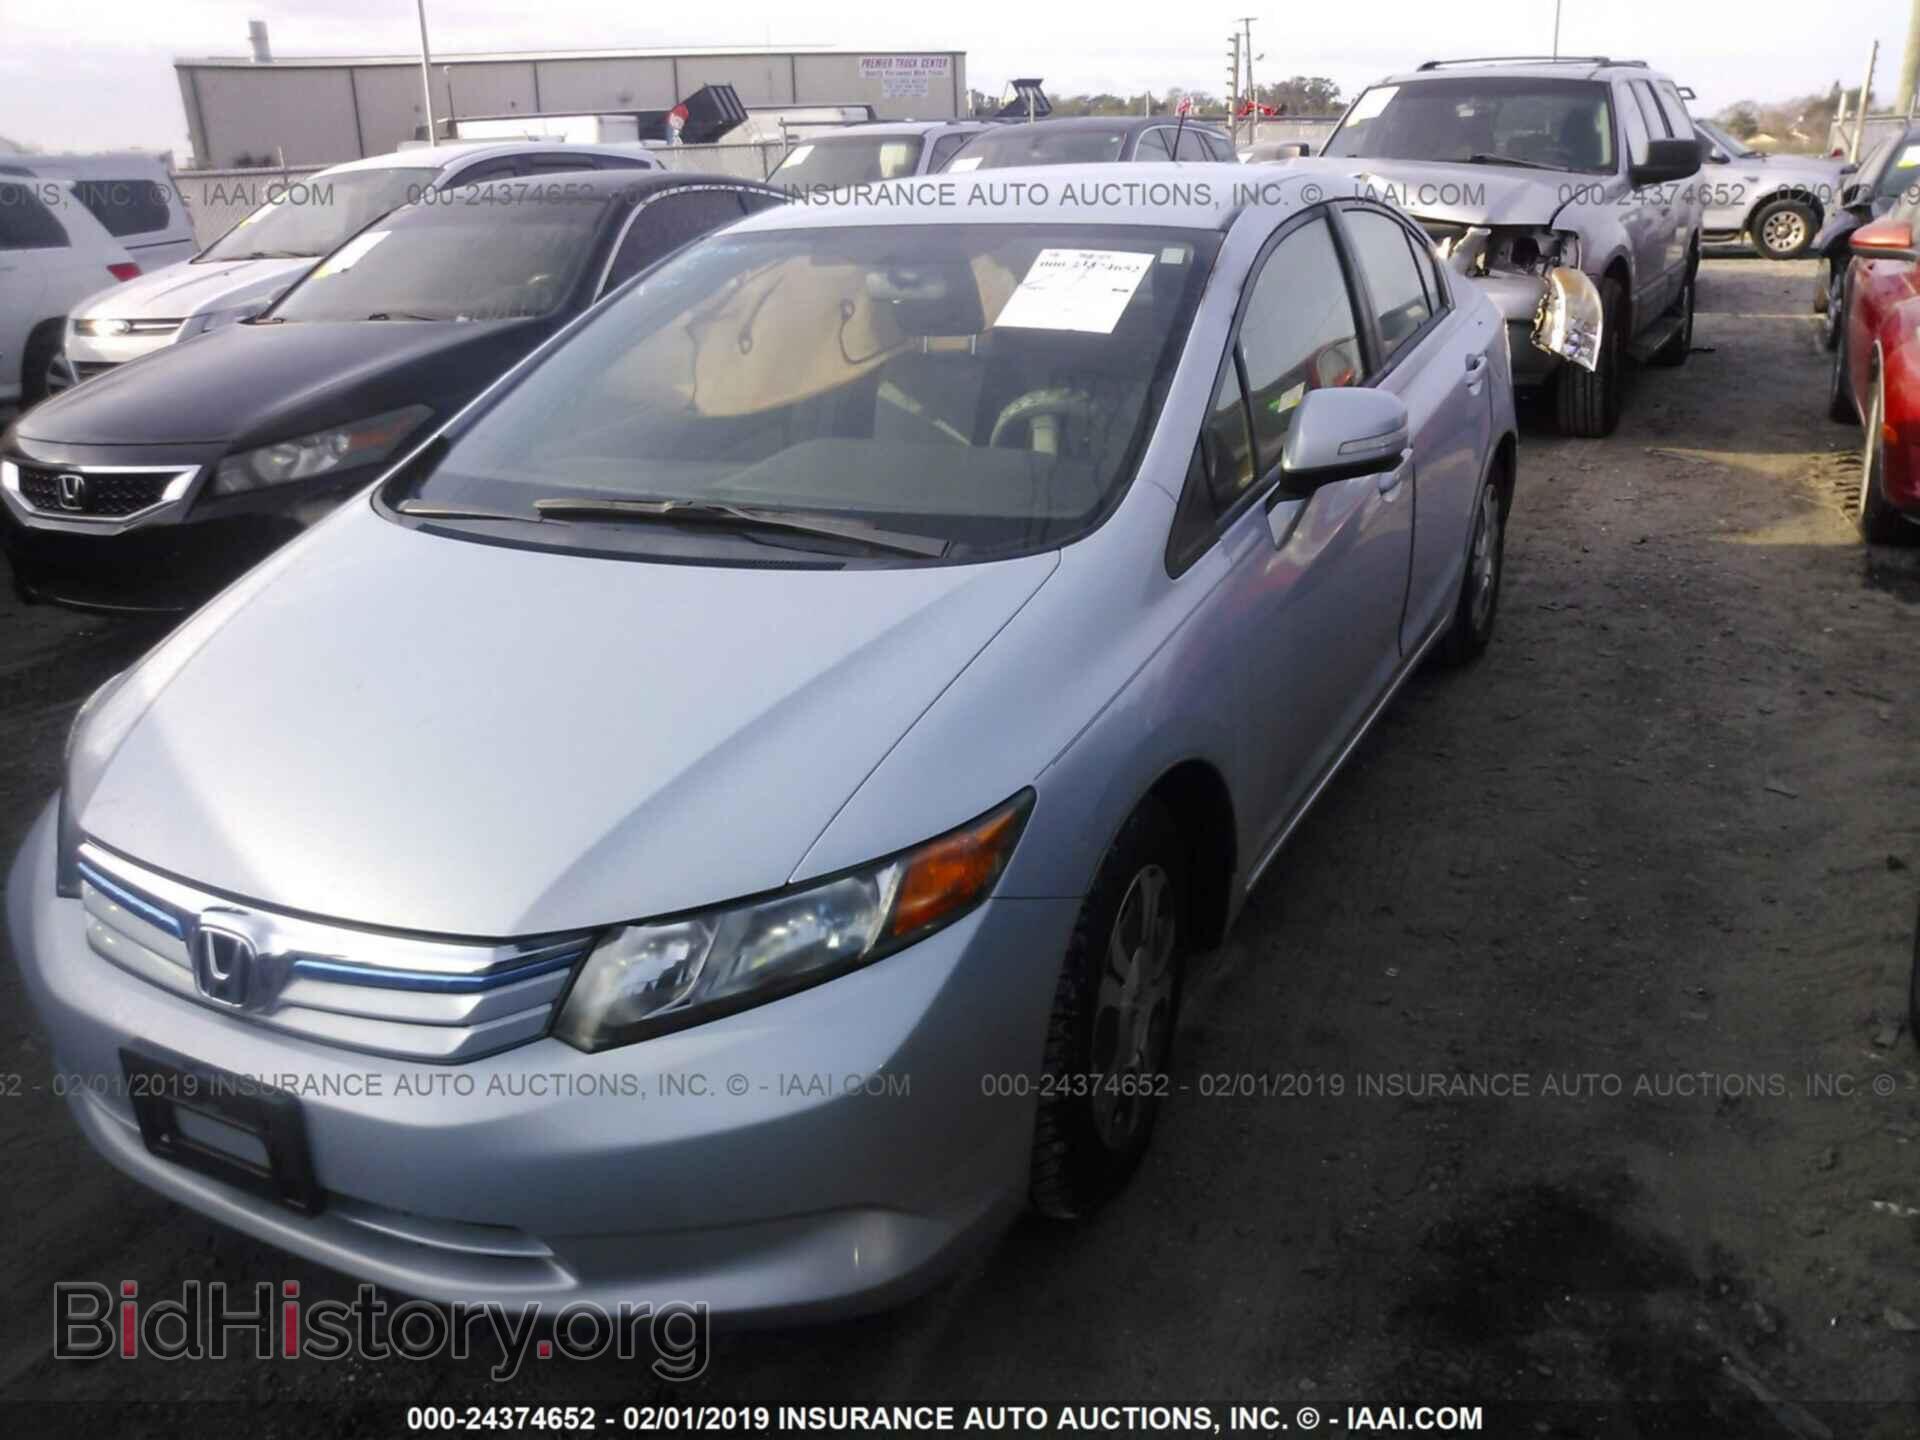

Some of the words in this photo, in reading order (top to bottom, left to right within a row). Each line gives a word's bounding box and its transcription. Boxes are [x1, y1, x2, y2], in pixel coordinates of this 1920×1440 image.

[862, 58, 892, 68] PREMIER
[896, 58, 917, 68] TRUCK
[921, 58, 947, 68] CENTER
